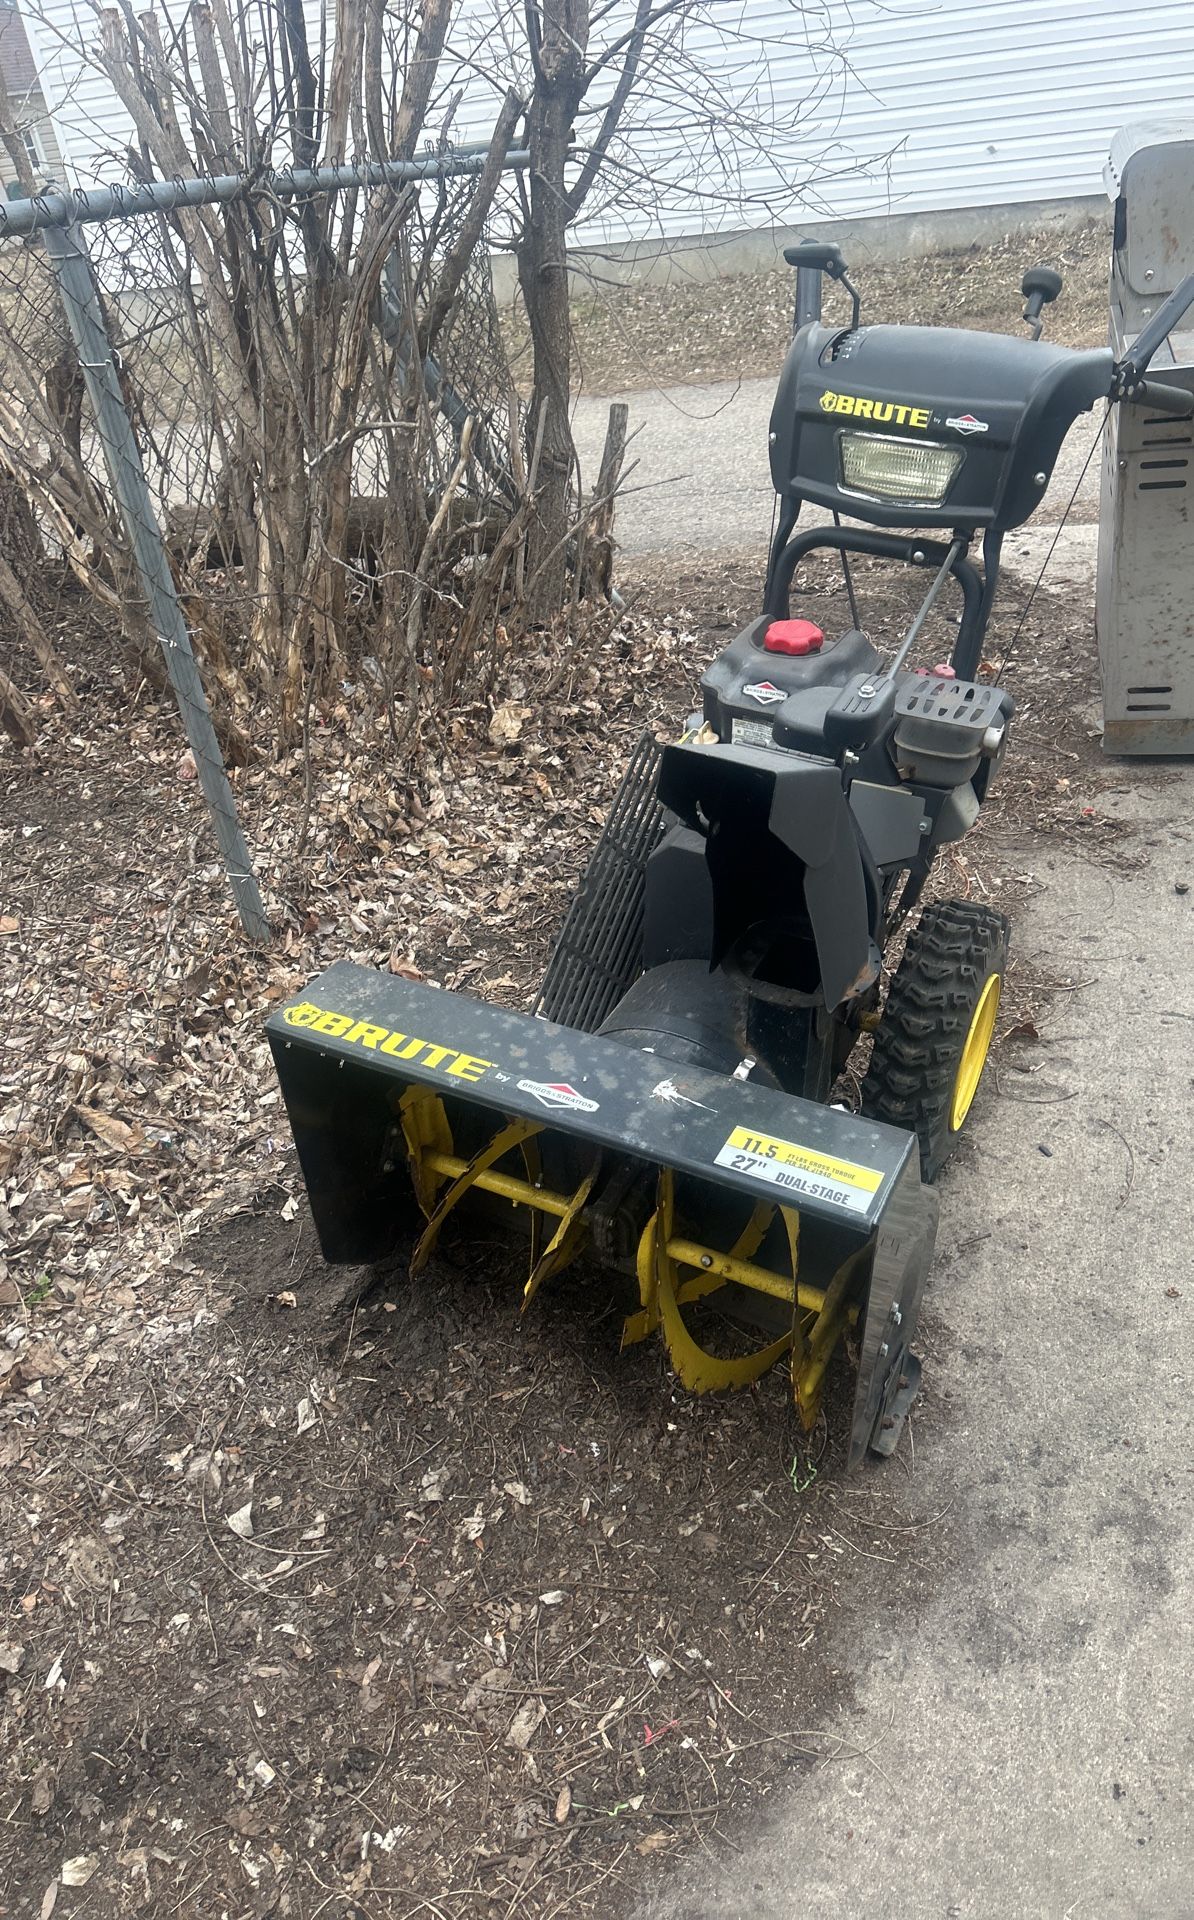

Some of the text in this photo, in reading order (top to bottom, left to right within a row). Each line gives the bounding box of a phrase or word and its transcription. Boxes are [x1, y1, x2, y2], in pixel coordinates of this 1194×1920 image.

[835, 394, 930, 429] BRUTE
[309, 1009, 493, 1082] BRUTE
[494, 1072, 510, 1082] by
[741, 1137, 779, 1159] 11.5
[730, 1154, 768, 1172] 27"
[809, 1159, 830, 1172] GROSS
[775, 1171, 851, 1205] DUAL-STAGE
